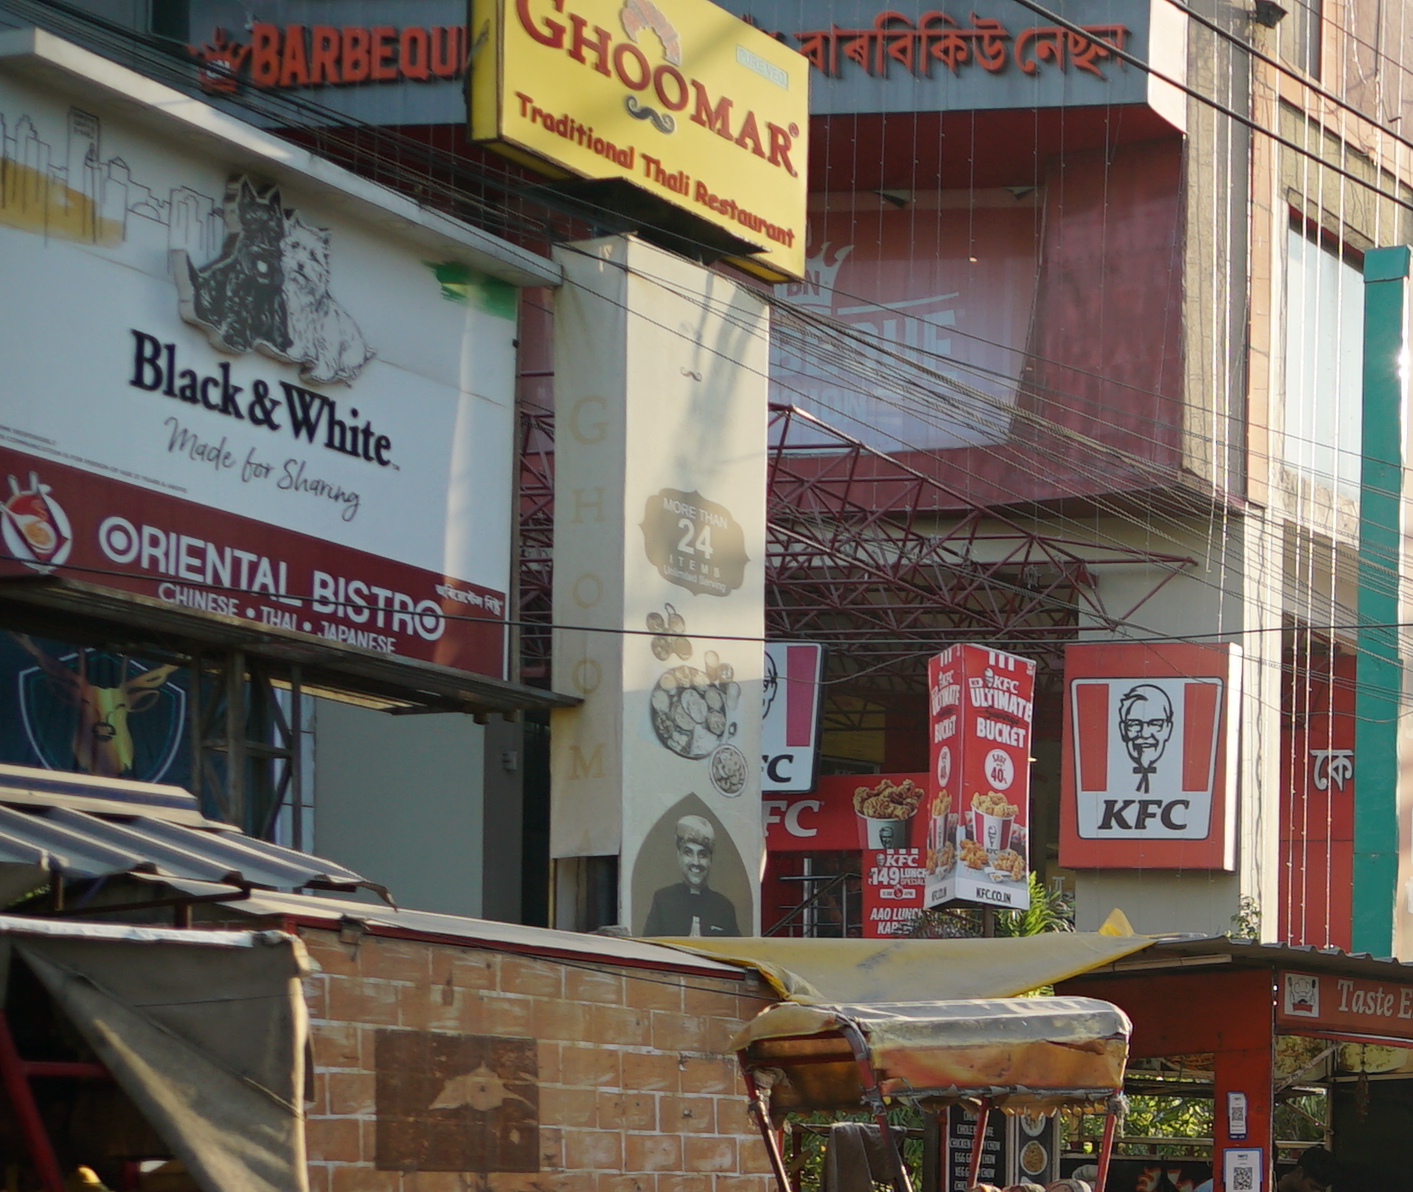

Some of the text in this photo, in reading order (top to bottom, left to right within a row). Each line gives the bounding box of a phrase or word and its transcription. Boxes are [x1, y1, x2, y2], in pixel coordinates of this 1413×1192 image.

[251, 22, 467, 87] BARBEQU
[516, 0, 798, 178] GHOOMAR
[516, 91, 795, 248] Traditional Thali Restaurant
[164, 416, 361, 522] Made for Sharing
[663, 496, 728, 529] MORE THAN
[677, 518, 714, 560] 24
[98, 516, 445, 641] ORIENTAL BISTRO
[158, 583, 397, 655] CHINESE THAI JAPANESE
[993, 675, 1020, 694] KFC
[970, 687, 1032, 723] ULTIMATE
[976, 717, 1026, 748] BUCKET
[1309, 749, 1354, 792] কে
[762, 799, 820, 838] FC
[1099, 799, 1190, 831] KFC
[885, 854, 919, 867] KFC
[870, 907, 892, 920] AAO
[976, 886, 1012, 904] KFC.CO.IN
[1337, 979, 1394, 1017] Taste
